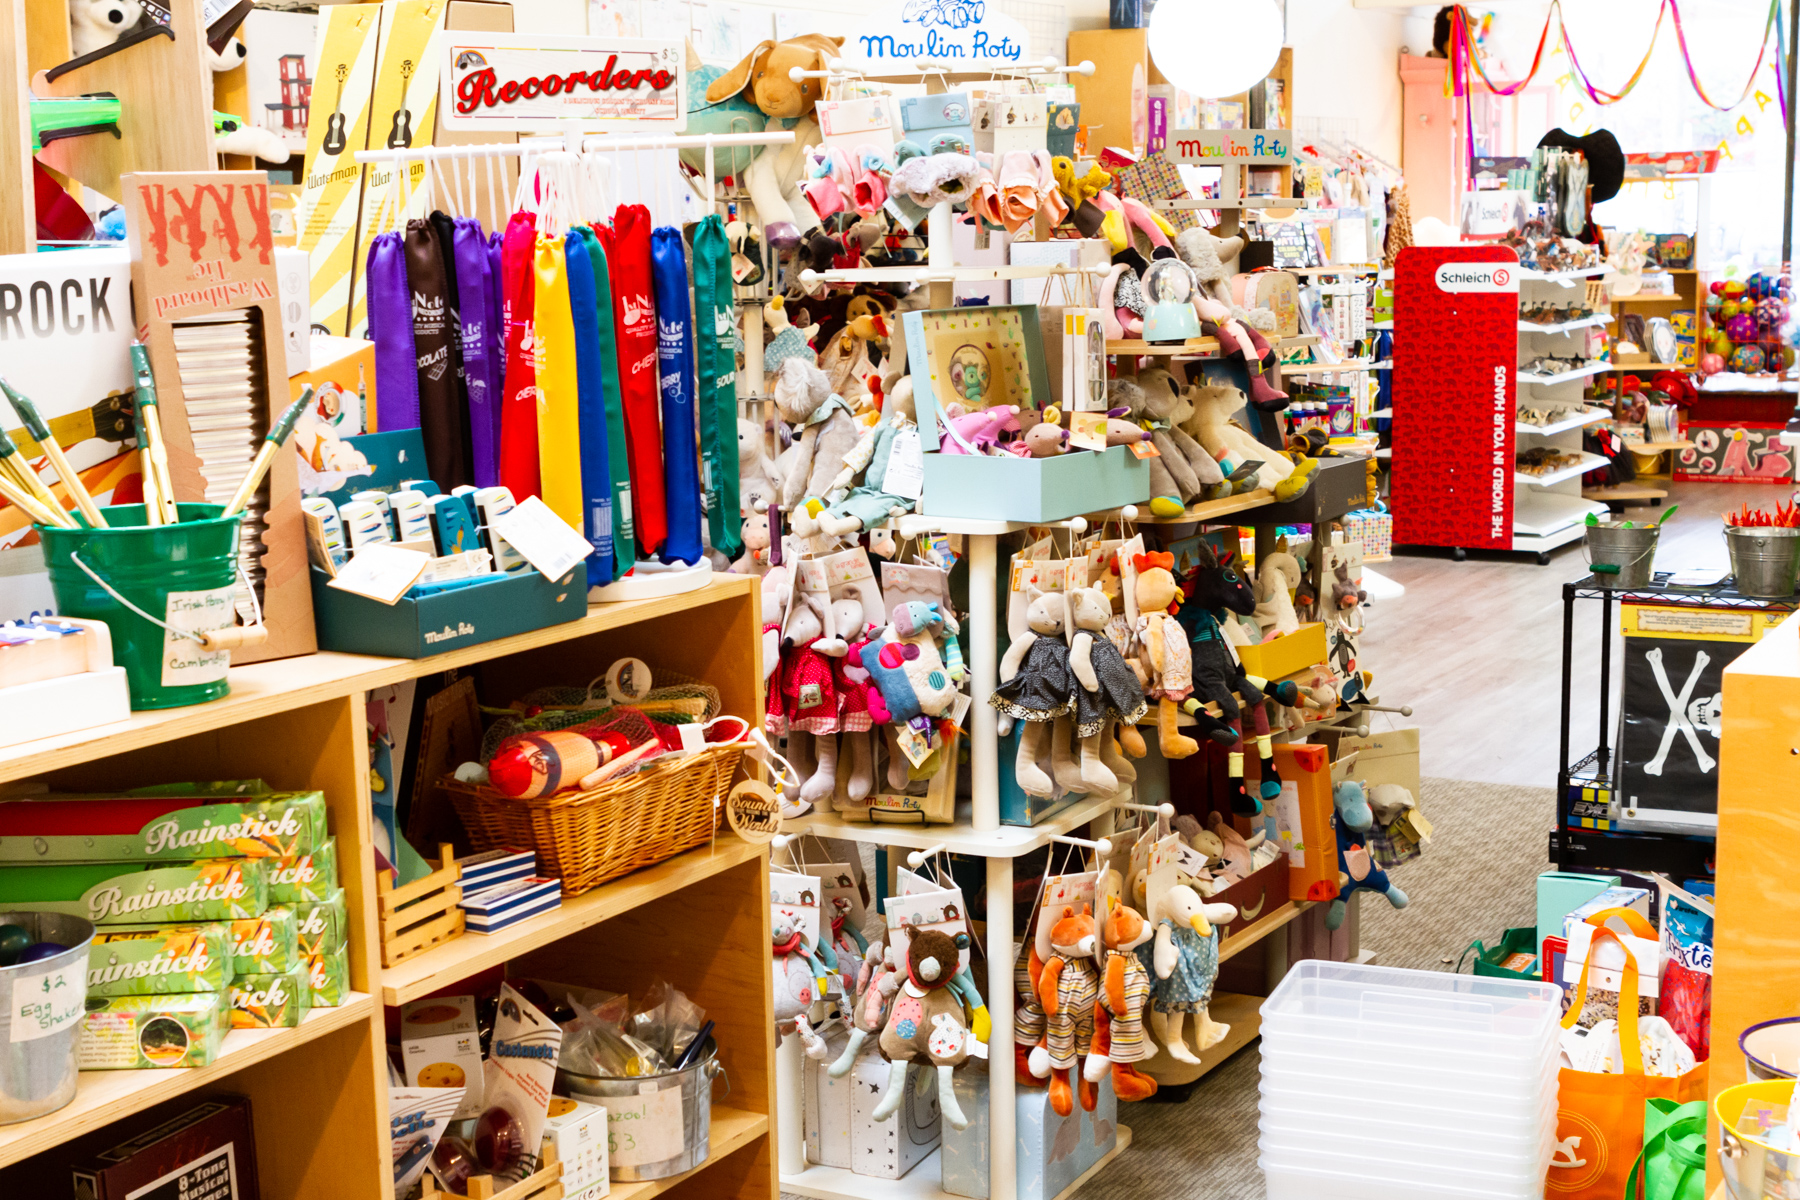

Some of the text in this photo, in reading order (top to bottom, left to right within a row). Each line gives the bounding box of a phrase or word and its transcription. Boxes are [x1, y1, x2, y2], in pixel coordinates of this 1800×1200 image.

[859, 28, 1021, 61] Moulin Roty
[456, 54, 675, 113] Recorders
[1176, 134, 1287, 158] Moulin Roty
[307, 165, 357, 190] Waterman
[1441, 271, 1491, 283] Schleich
[153, 277, 275, 318] Washboard
[0, 277, 115, 343] ROCK
[1491, 365, 1507, 539] THE WORLD IN YOUR HANDS
[424, 621, 475, 645] Moulin Roty
[729, 792, 779, 814] Sounds
[864, 796, 921, 811] Moulin Roty
[145, 807, 302, 855] Rainstick
[734, 813, 778, 833] World
[87, 870, 248, 921] Rainstick
[41, 974, 67, 994] $2
[20, 1001, 52, 1020] Egg
[495, 1039, 554, 1060] Castanets
[607, 1130, 637, 1154] $3
[178, 1158, 227, 1191] 8-Tone
